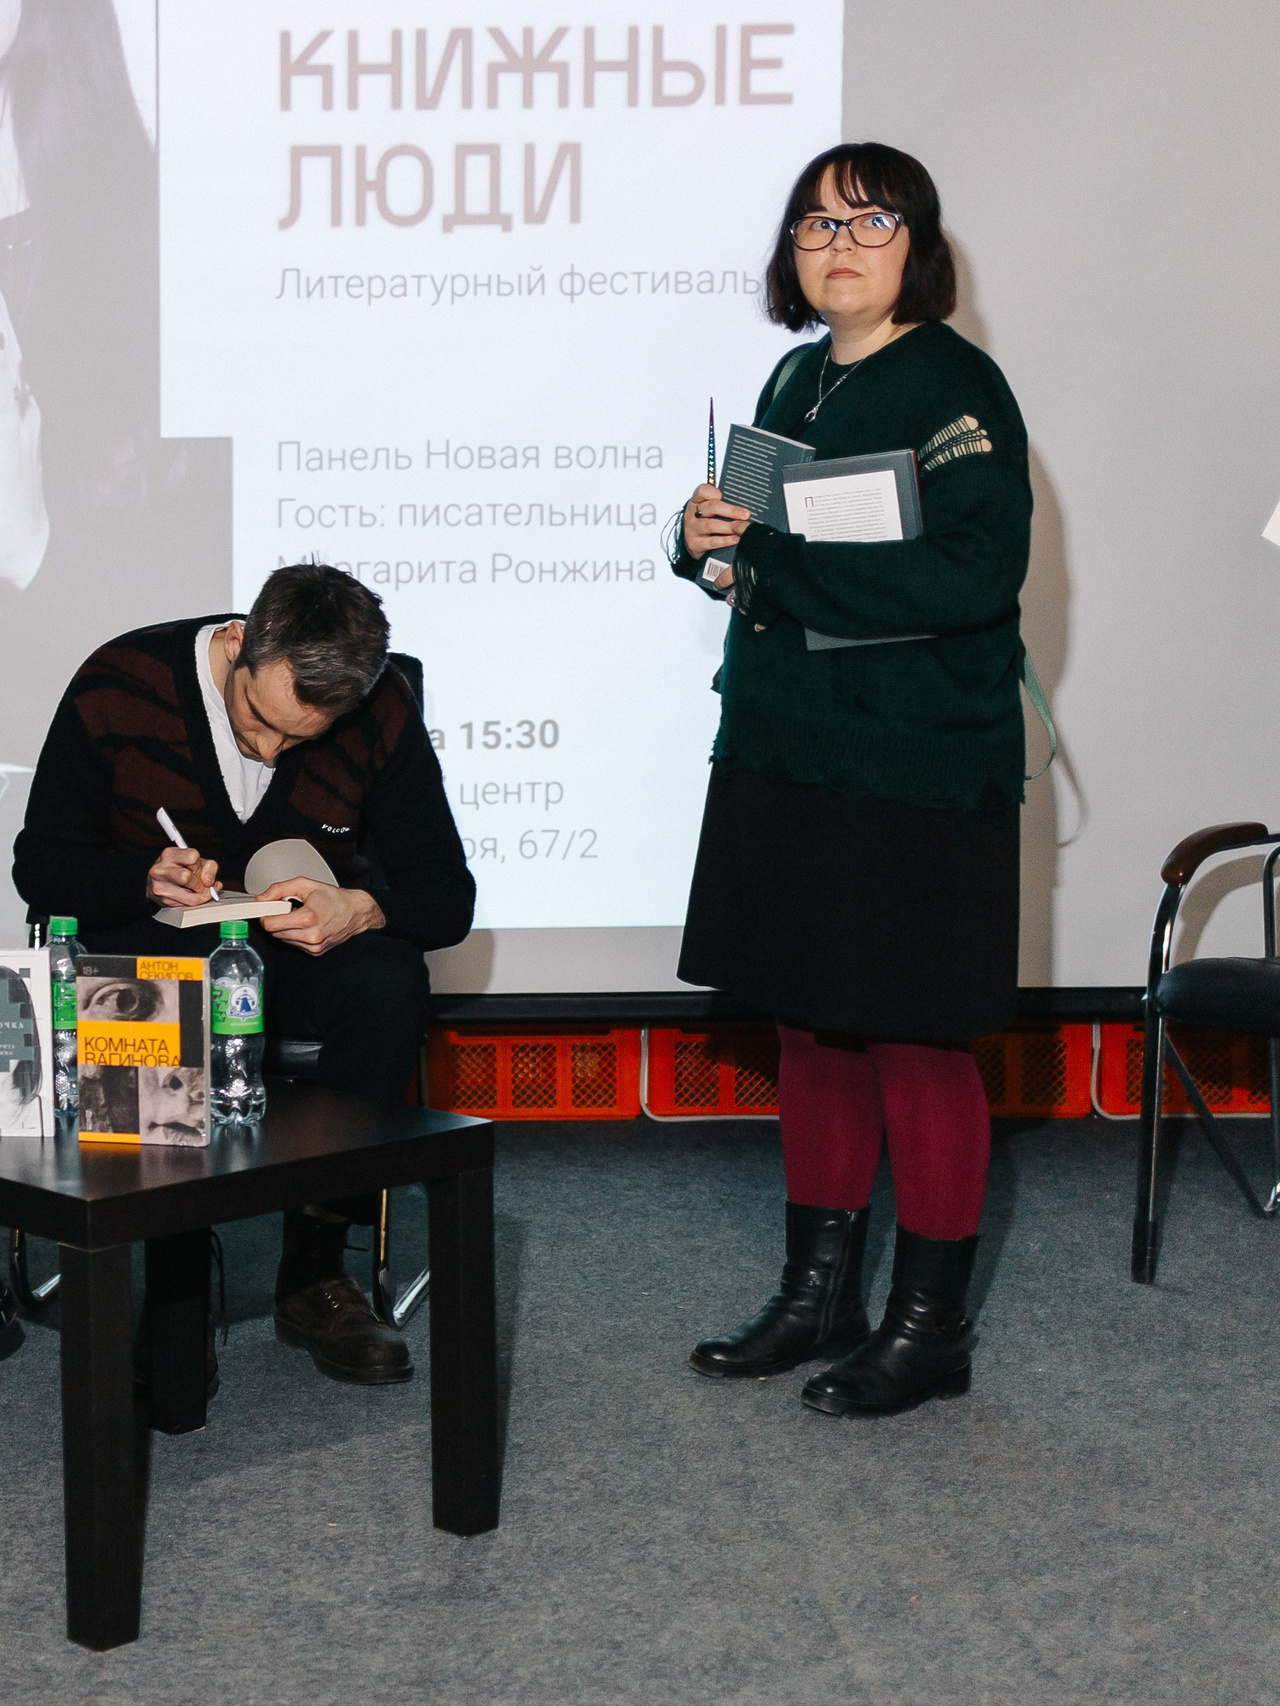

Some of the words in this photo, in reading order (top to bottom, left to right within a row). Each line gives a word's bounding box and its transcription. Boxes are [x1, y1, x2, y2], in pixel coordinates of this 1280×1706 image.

[278, 23, 795, 112] КНИЖНЫЕ
[278, 141, 583, 234] ЛЮДИ
[275, 265, 548, 307] Литературный
[558, 264, 761, 304] фестиваль
[277, 440, 413, 472] Панель
[425, 439, 541, 470] Новая
[553, 444, 665, 470] волна
[277, 498, 386, 529] Гость:
[398, 501, 658, 532] писательница
[491, 552, 657, 584] Ронжина
[459, 718, 560, 750] 15:30
[460, 780, 564, 812] центр
[520, 828, 599, 861] 67/2
[140, 961, 179, 972] АНТОН
[84, 1036, 169, 1054] КОМНАТА
[84, 1051, 180, 1067] ВАГИНОВА
